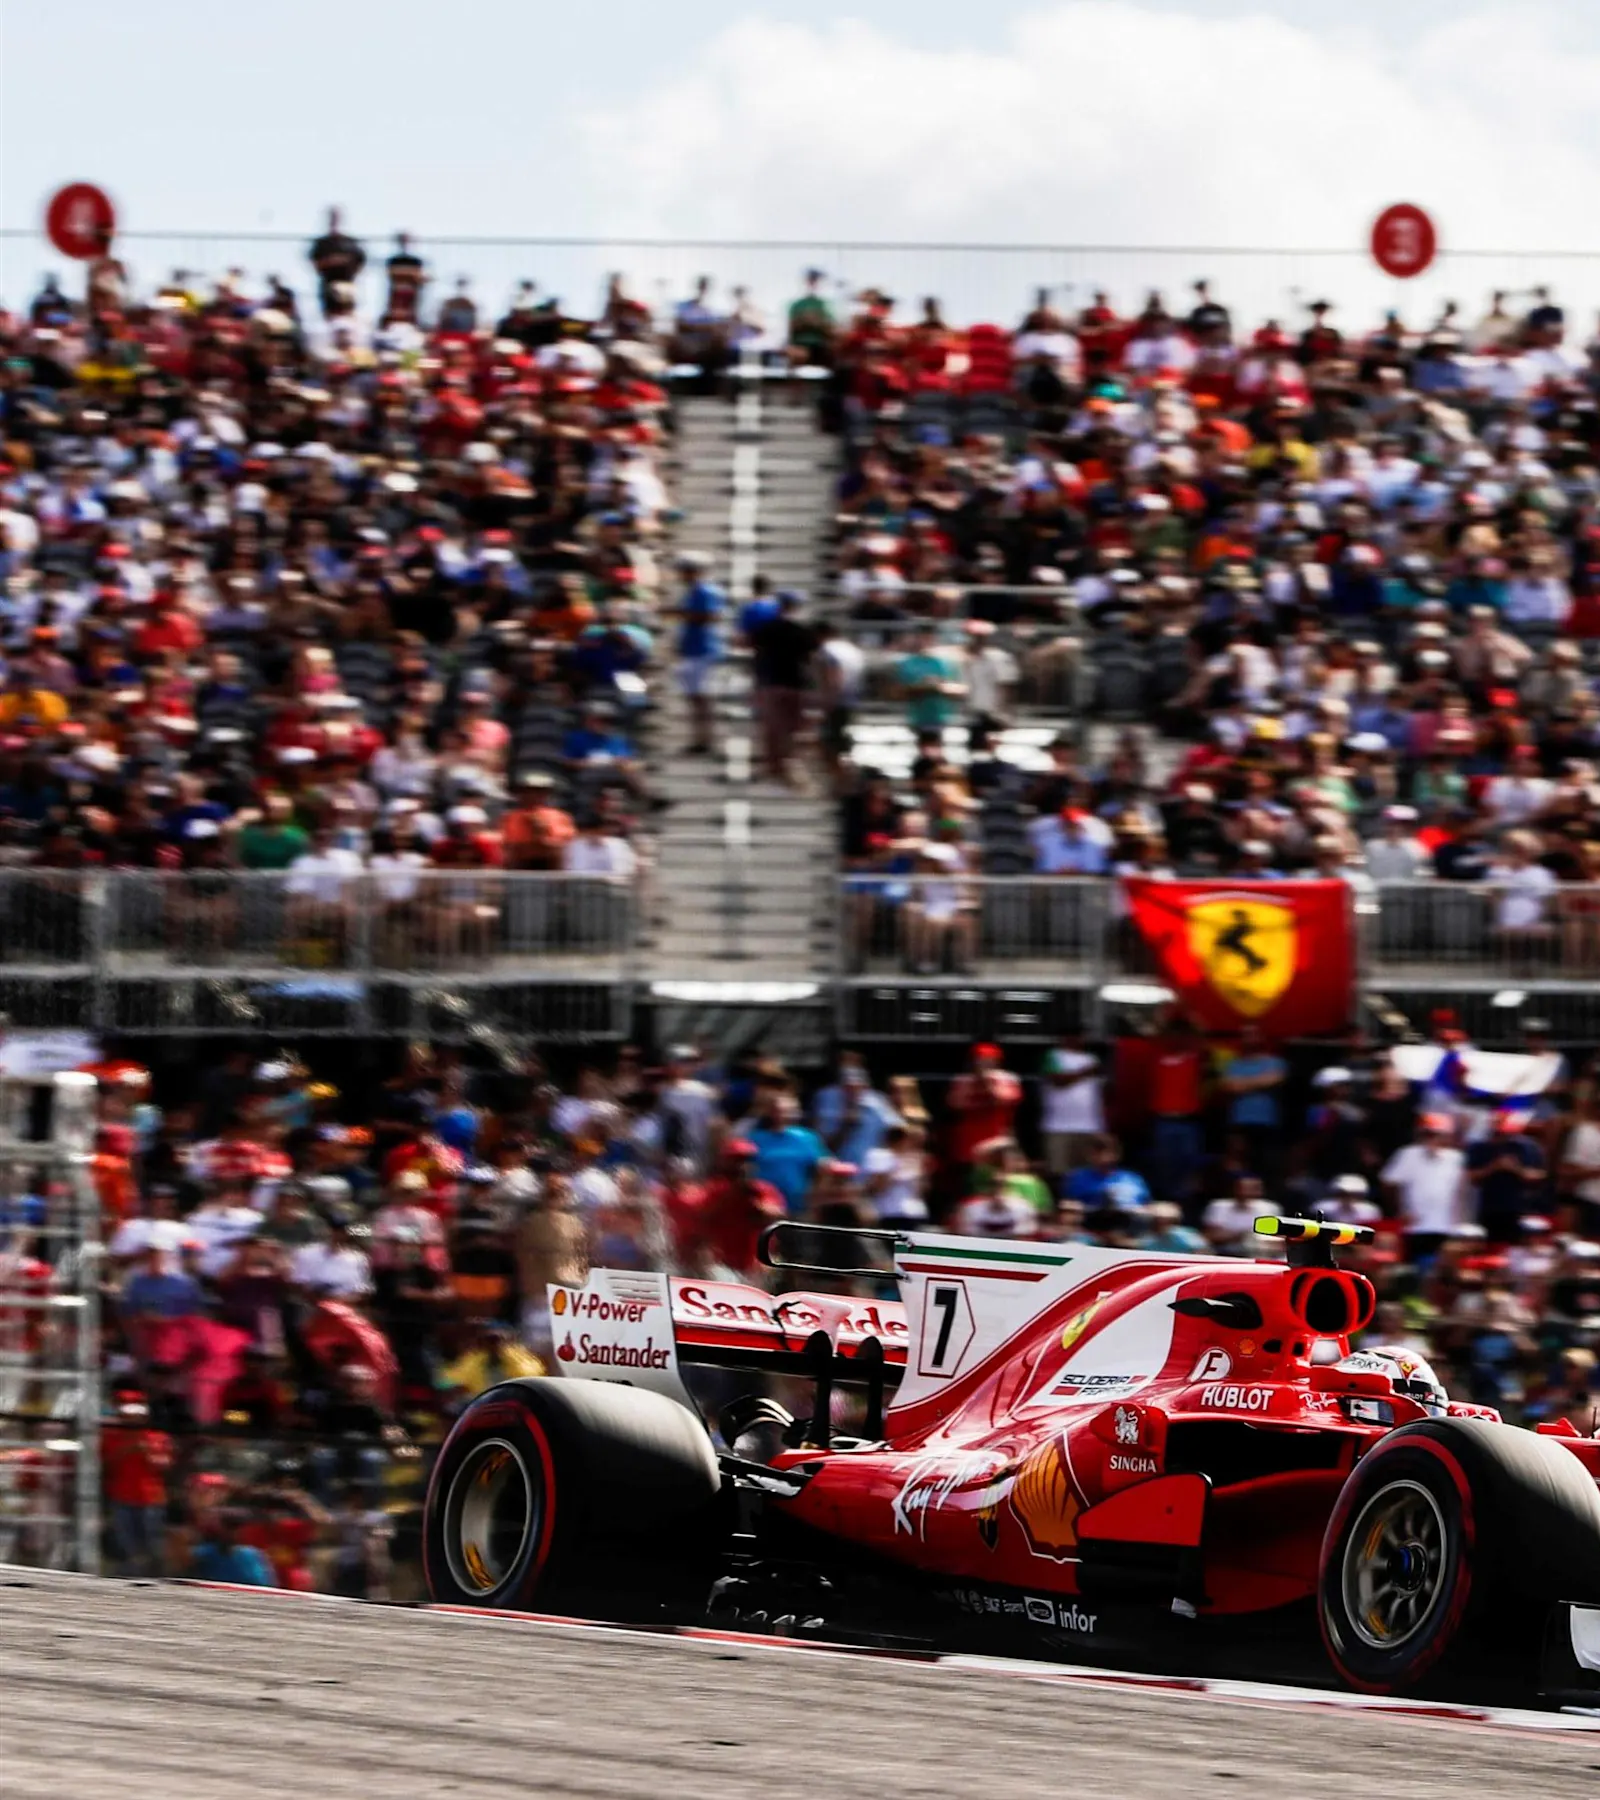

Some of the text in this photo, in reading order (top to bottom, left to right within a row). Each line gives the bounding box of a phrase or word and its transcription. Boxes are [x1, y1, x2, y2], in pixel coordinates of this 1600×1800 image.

[1385, 218, 1420, 263] 3
[570, 1291, 647, 1323] V-Power
[934, 1287, 958, 1368] 7
[577, 1333, 670, 1370] Santander
[1060, 1374, 1131, 1386] SCUDERIA
[1201, 1386, 1274, 1411] HUBLOT
[1109, 1455, 1157, 1473] SINGHA
[1059, 1603, 1098, 1633] infor
